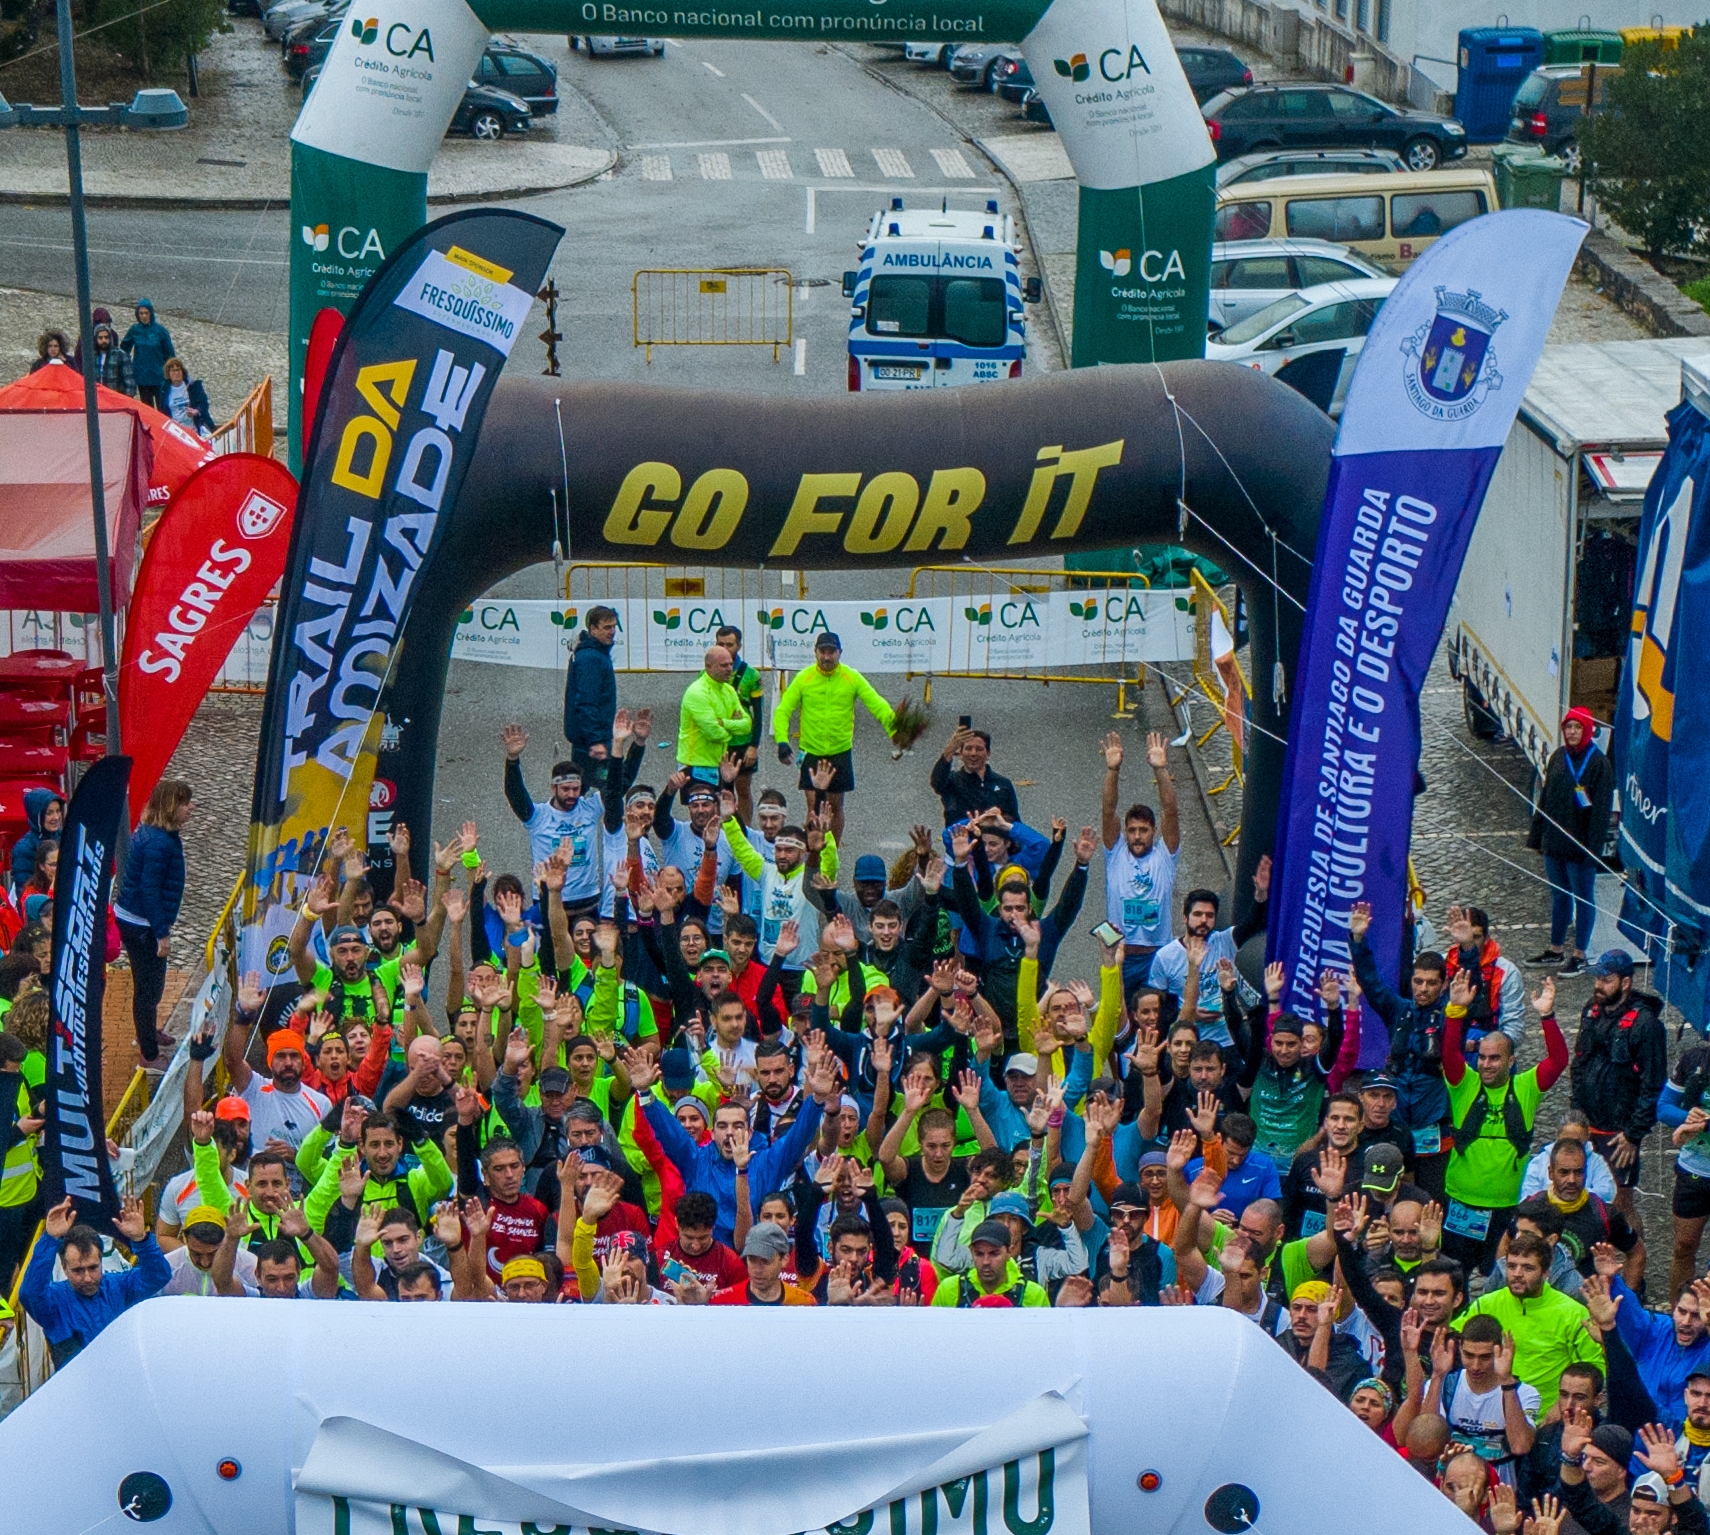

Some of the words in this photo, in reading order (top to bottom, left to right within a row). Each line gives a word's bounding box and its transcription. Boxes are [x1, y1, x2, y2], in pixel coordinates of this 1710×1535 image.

[582, 4, 596, 22] O
[601, 2, 671, 25] Banco
[675, 7, 762, 28] nacional
[770, 13, 814, 30] com
[821, 11, 927, 37] pronúncia
[934, 13, 985, 33] local
[386, 23, 434, 62] CA
[354, 57, 389, 74] Crédito
[391, 64, 433, 82] Agrícola
[1098, 44, 1152, 82] CA
[1074, 91, 1113, 106] Crédito
[1115, 83, 1155, 100] Agrícola
[337, 226, 387, 262] CA
[882, 252, 994, 270] AMBULÂNCIA
[311, 262, 345, 276] Crédito
[1140, 250, 1186, 283] CA
[1111, 287, 1147, 299] Crédito
[1148, 288, 1186, 301] Agrícola
[602, 461, 750, 551] GO
[769, 467, 987, 559] FOR
[315, 347, 486, 781] AMIZADE
[1341, 486, 1391, 611] GUARDA
[278, 516, 373, 802] TRAIL
[330, 358, 418, 500] DA
[1356, 494, 1438, 683] DESPORTO
[138, 538, 252, 683] SAGRES
[480, 606, 520, 633] CA
[689, 608, 727, 635] CA
[801, 607, 840, 634] CA
[896, 607, 936, 634] CA
[1000, 602, 1040, 628] CA
[1105, 596, 1147, 623] CA
[456, 632, 486, 643] Crédito
[487, 634, 522, 645] Agrícola
[872, 638, 903, 648] Crédito
[976, 632, 1006, 643] Crédito
[1335, 615, 1360, 658] DA
[1351, 685, 1386, 715] O
[1318, 659, 1353, 797] SANTIAGO
[1347, 715, 1382, 743] E
[1313, 804, 1337, 840] DE
[1327, 746, 1377, 899] CULTURA
[1291, 849, 1332, 995] FREGUESIA
[916, 1214, 938, 1227] 817
[1450, 1204, 1469, 1222] 666
